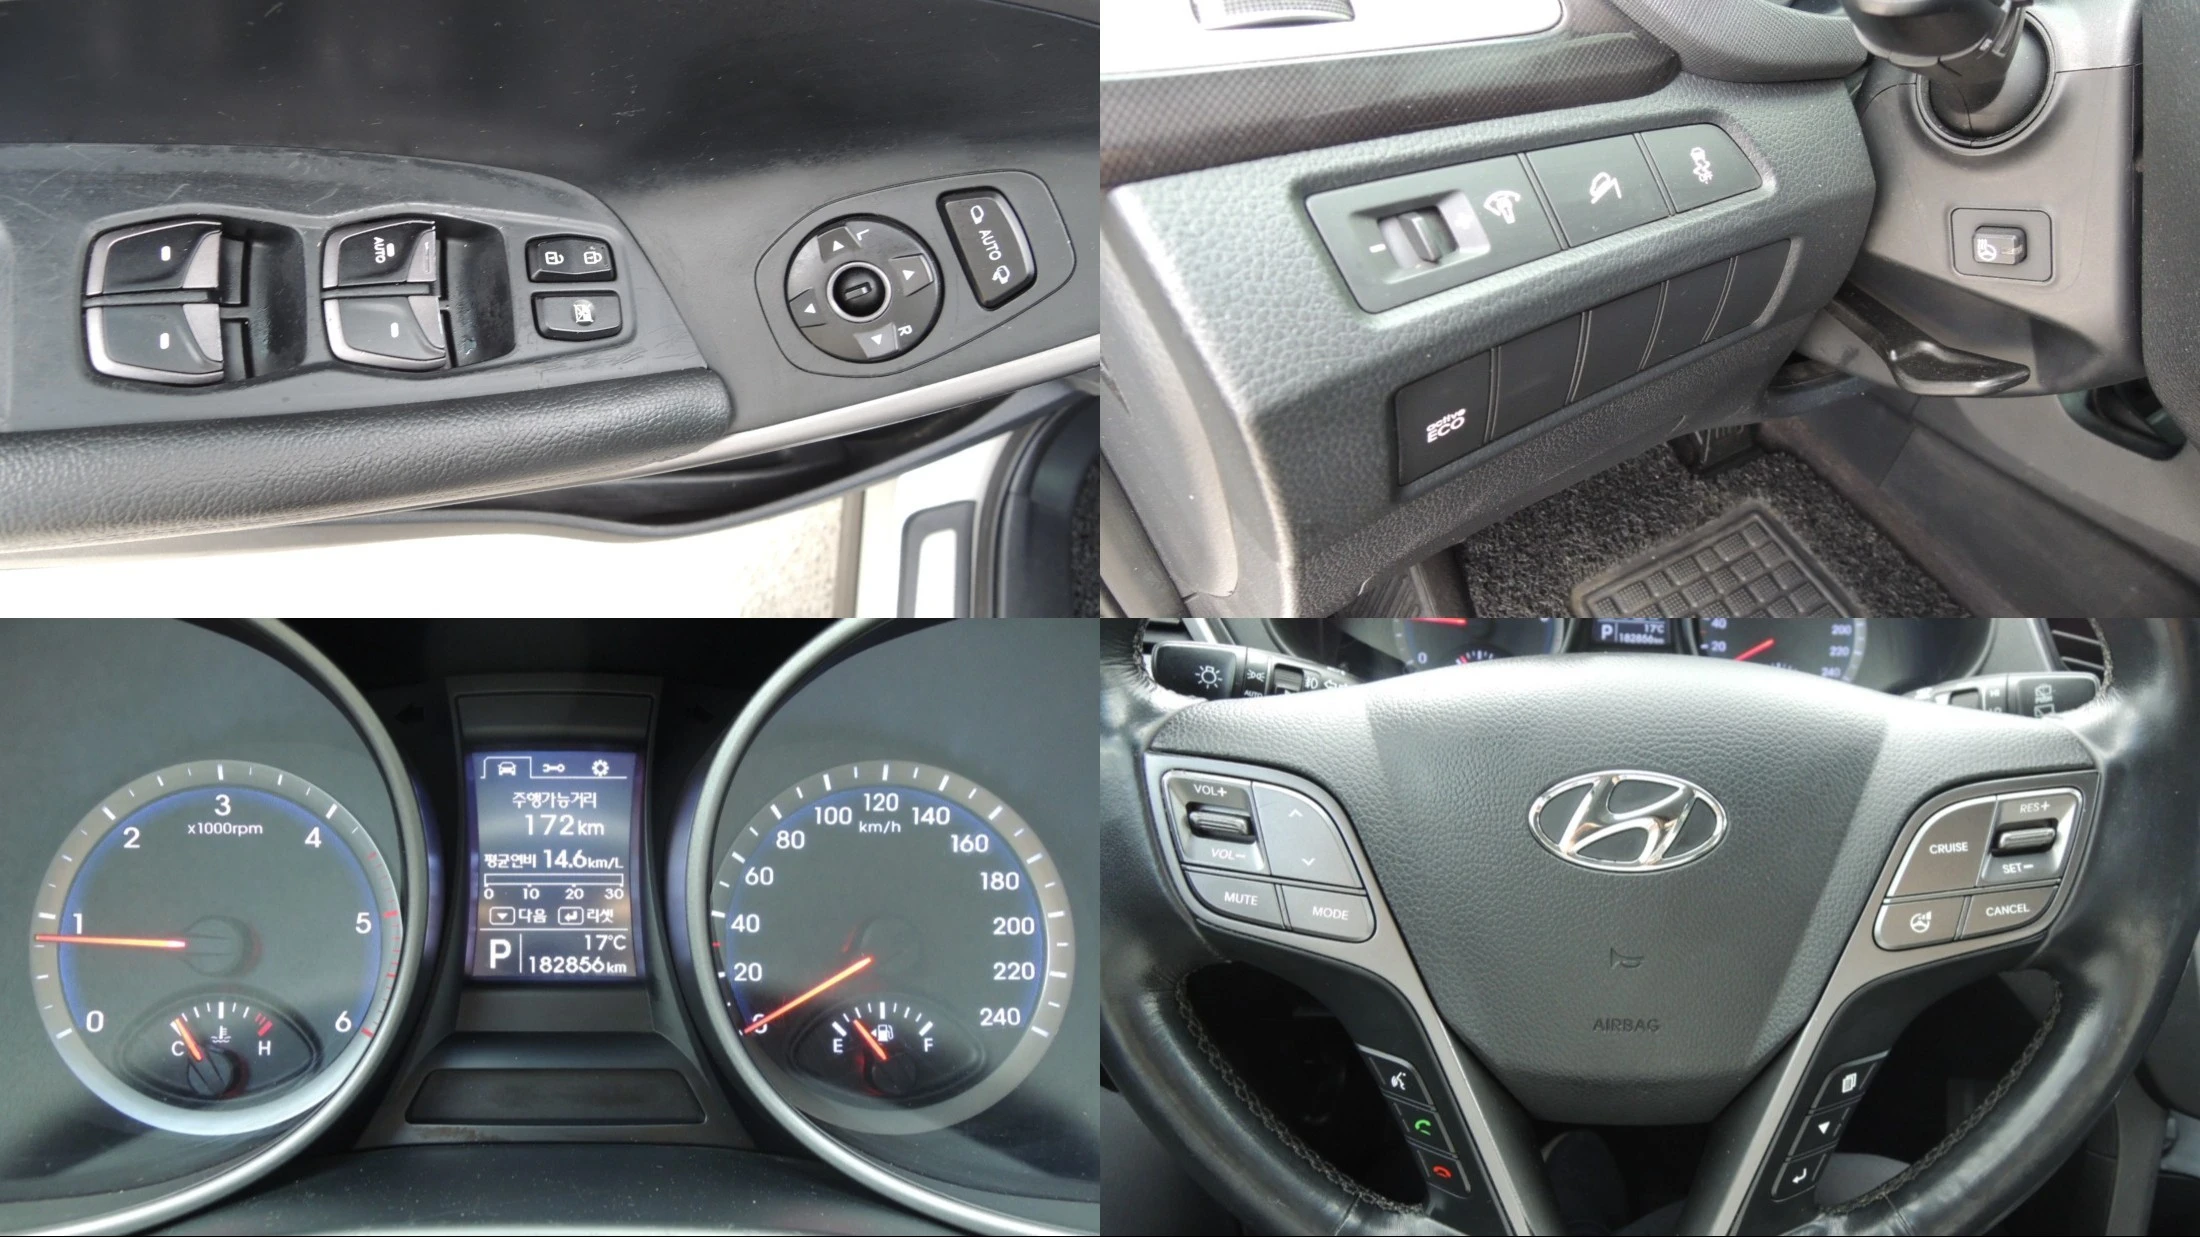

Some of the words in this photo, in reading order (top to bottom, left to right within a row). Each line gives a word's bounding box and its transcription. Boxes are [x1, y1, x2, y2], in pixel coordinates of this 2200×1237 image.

[373, 236, 386, 263] AUTO
[979, 229, 1002, 262] AUTO
[898, 324, 913, 336] R
[1426, 408, 1466, 431] active
[1427, 416, 1465, 443] ECO
[1601, 624, 1613, 640] P
[1831, 625, 1852, 635] 200
[1711, 641, 1727, 652] 20
[1418, 652, 1427, 664] 0
[214, 794, 231, 816] 3
[512, 791, 597, 809] 주행가능거리
[863, 793, 899, 812] 120
[815, 806, 853, 825] 100
[912, 806, 950, 825] 140
[187, 822, 263, 837] x1000rpm
[858, 820, 901, 834] km/h
[123, 827, 141, 848] 2
[305, 827, 322, 848] 4
[776, 830, 805, 850] 80
[951, 834, 989, 853] 160
[1929, 841, 1968, 855] CRUISE
[484, 853, 537, 868] 평균연비
[745, 867, 774, 886] 60
[980, 871, 1020, 891] 180
[484, 888, 494, 900] 0
[523, 888, 540, 900] 10
[565, 888, 584, 900] 20
[604, 888, 624, 900] 30
[1224, 891, 1258, 906] MUTE
[518, 908, 547, 923] 다음
[587, 908, 614, 923] 리셋
[1312, 906, 1349, 920] MODE
[1986, 903, 2030, 917] CANCEL
[72, 913, 83, 934] 1
[355, 913, 372, 934] 5
[731, 914, 760, 933] 40
[993, 917, 1035, 935] 200
[490, 939, 512, 969] P
[734, 963, 762, 981] 20
[993, 962, 1035, 980] 220
[86, 1010, 104, 1032] 0
[335, 1010, 352, 1032] 6
[980, 1008, 1021, 1026] 240
[1592, 1017, 1660, 1033] AIRBAG
[171, 1041, 185, 1057] C
[258, 1041, 271, 1056] H
[833, 1039, 843, 1053] E
[924, 1038, 933, 1052] F
